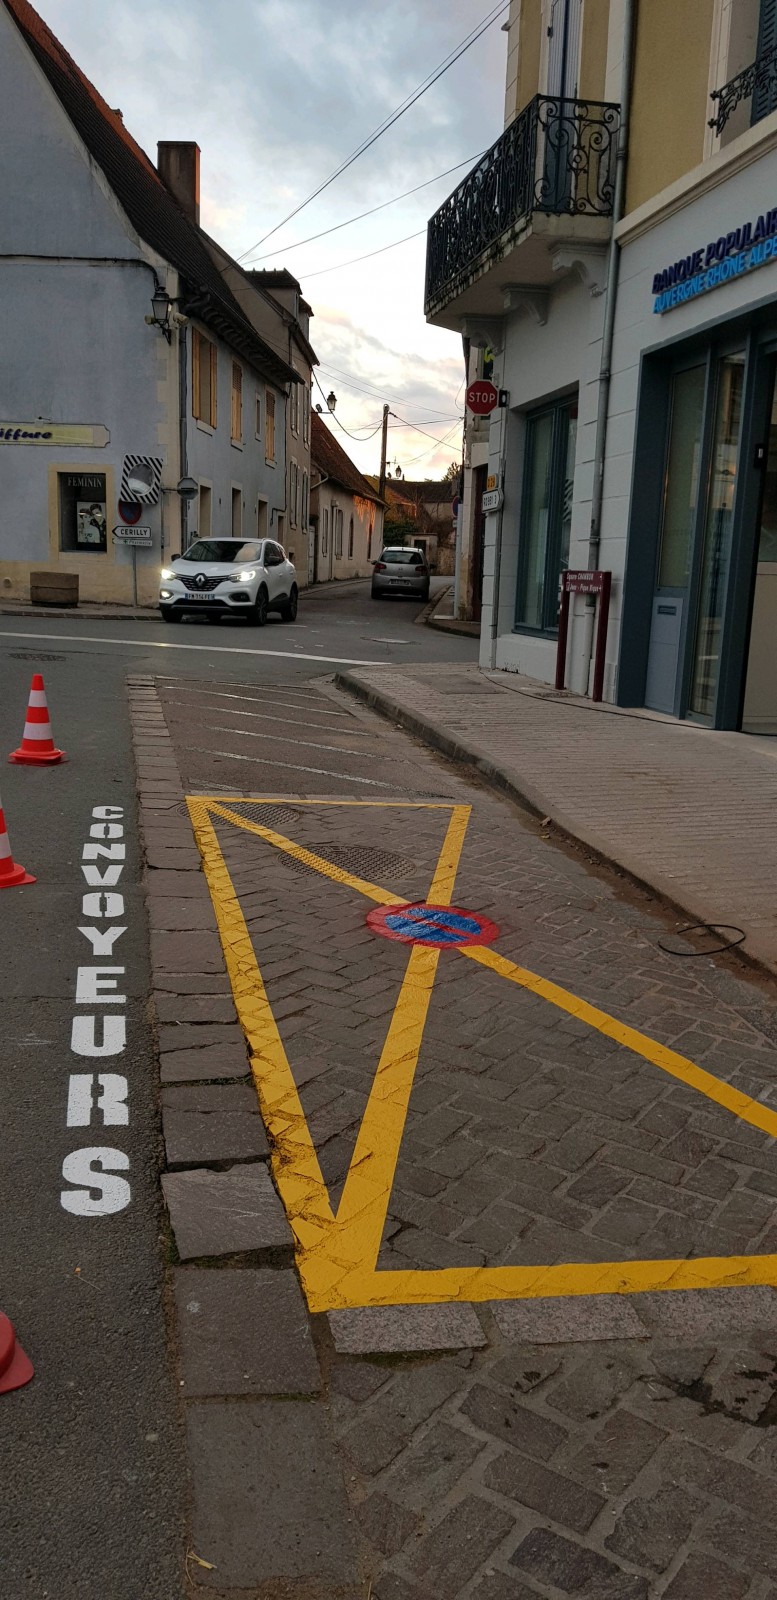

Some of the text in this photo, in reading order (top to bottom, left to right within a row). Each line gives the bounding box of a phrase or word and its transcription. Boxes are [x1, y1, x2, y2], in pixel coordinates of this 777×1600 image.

[652, 248, 705, 294] BANQUE
[653, 272, 706, 314] AUVERGNE
[468, 392, 496, 403] STOP
[67, 476, 102, 488] FEMININ
[120, 528, 148, 536] CERILLY
[60, 805, 131, 1217] CONVOYEURS
